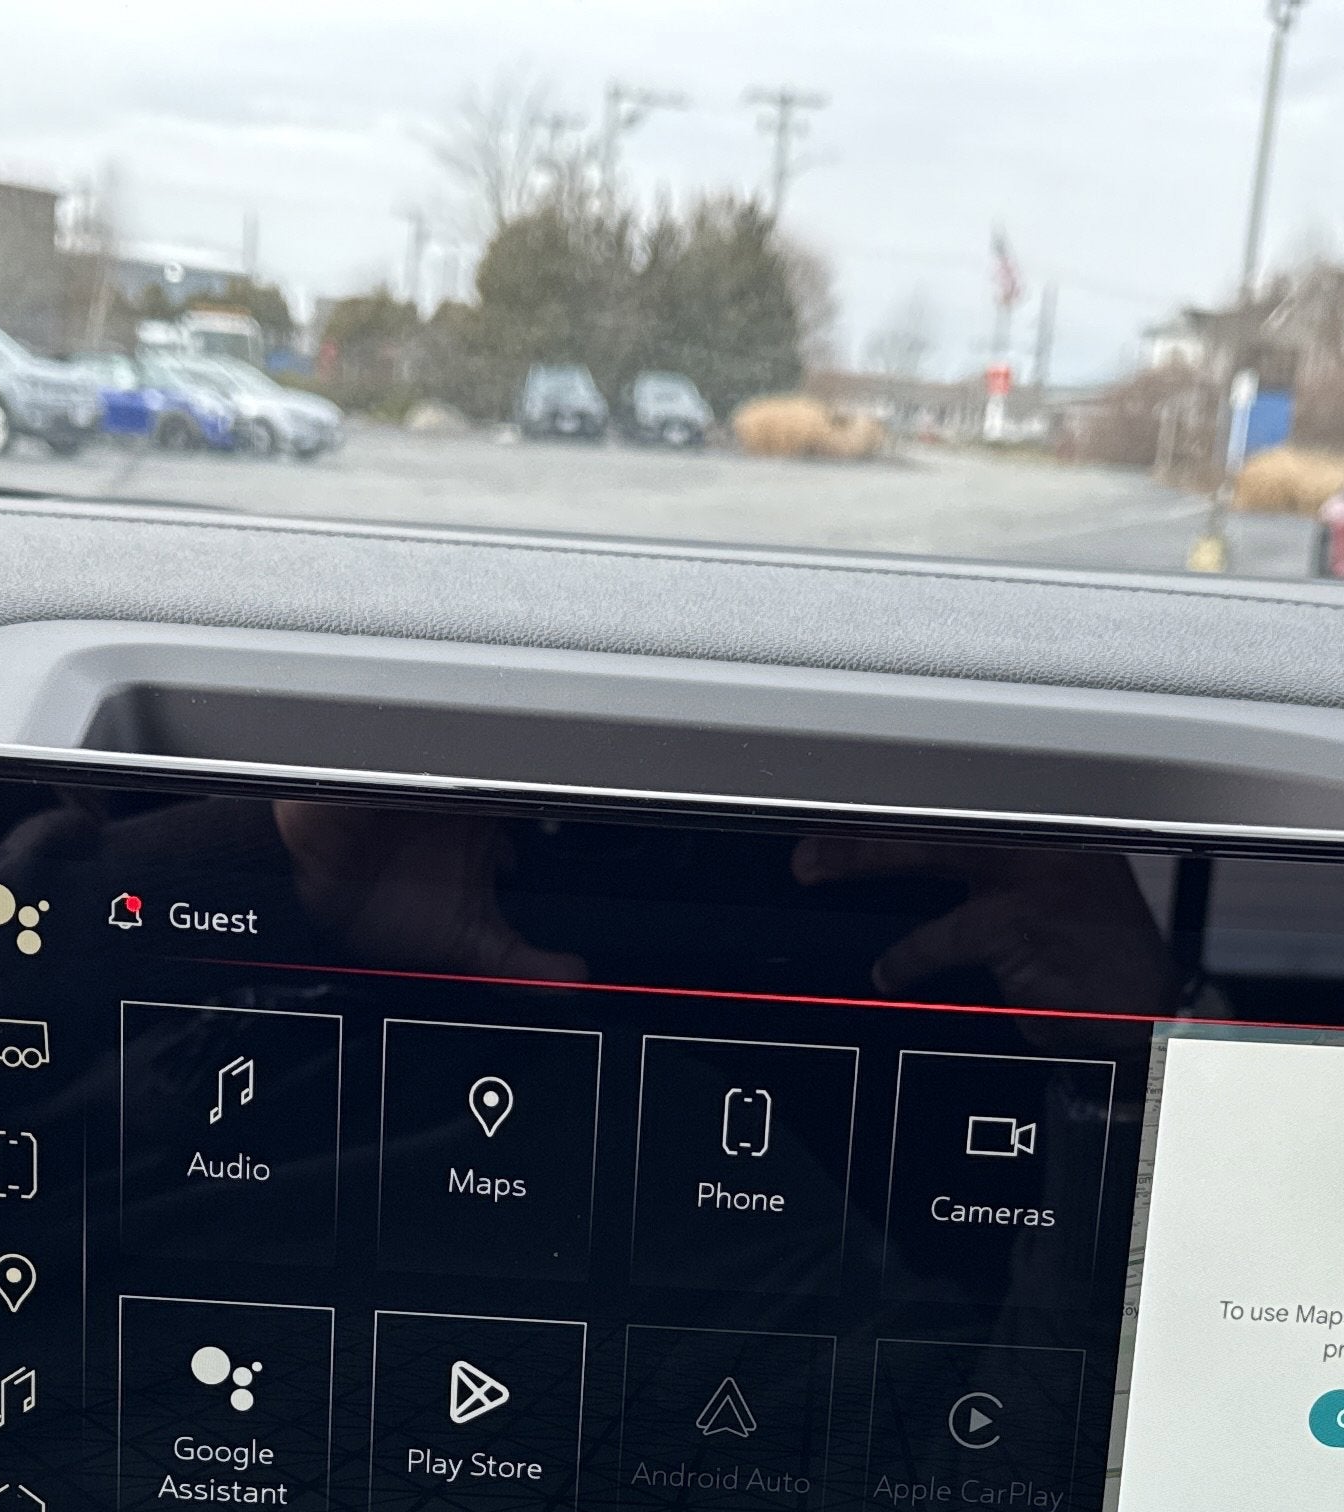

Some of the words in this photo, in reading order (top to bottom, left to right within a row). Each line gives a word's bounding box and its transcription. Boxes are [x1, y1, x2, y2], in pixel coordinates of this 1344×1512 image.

[169, 902, 258, 935] Guest
[186, 1151, 270, 1181] Audio
[448, 1167, 527, 1203] Maps
[697, 1181, 785, 1212] Phone
[931, 1195, 1056, 1227] Cameras
[1219, 1300, 1244, 1321] To
[1250, 1306, 1289, 1323] use
[173, 1436, 274, 1469] Google
[408, 1448, 464, 1483] Play
[470, 1452, 543, 1480] Store
[157, 1474, 288, 1505] Assistant
[630, 1461, 739, 1490] Android
[745, 1467, 811, 1494] Auto
[872, 1474, 952, 1507] Apple
